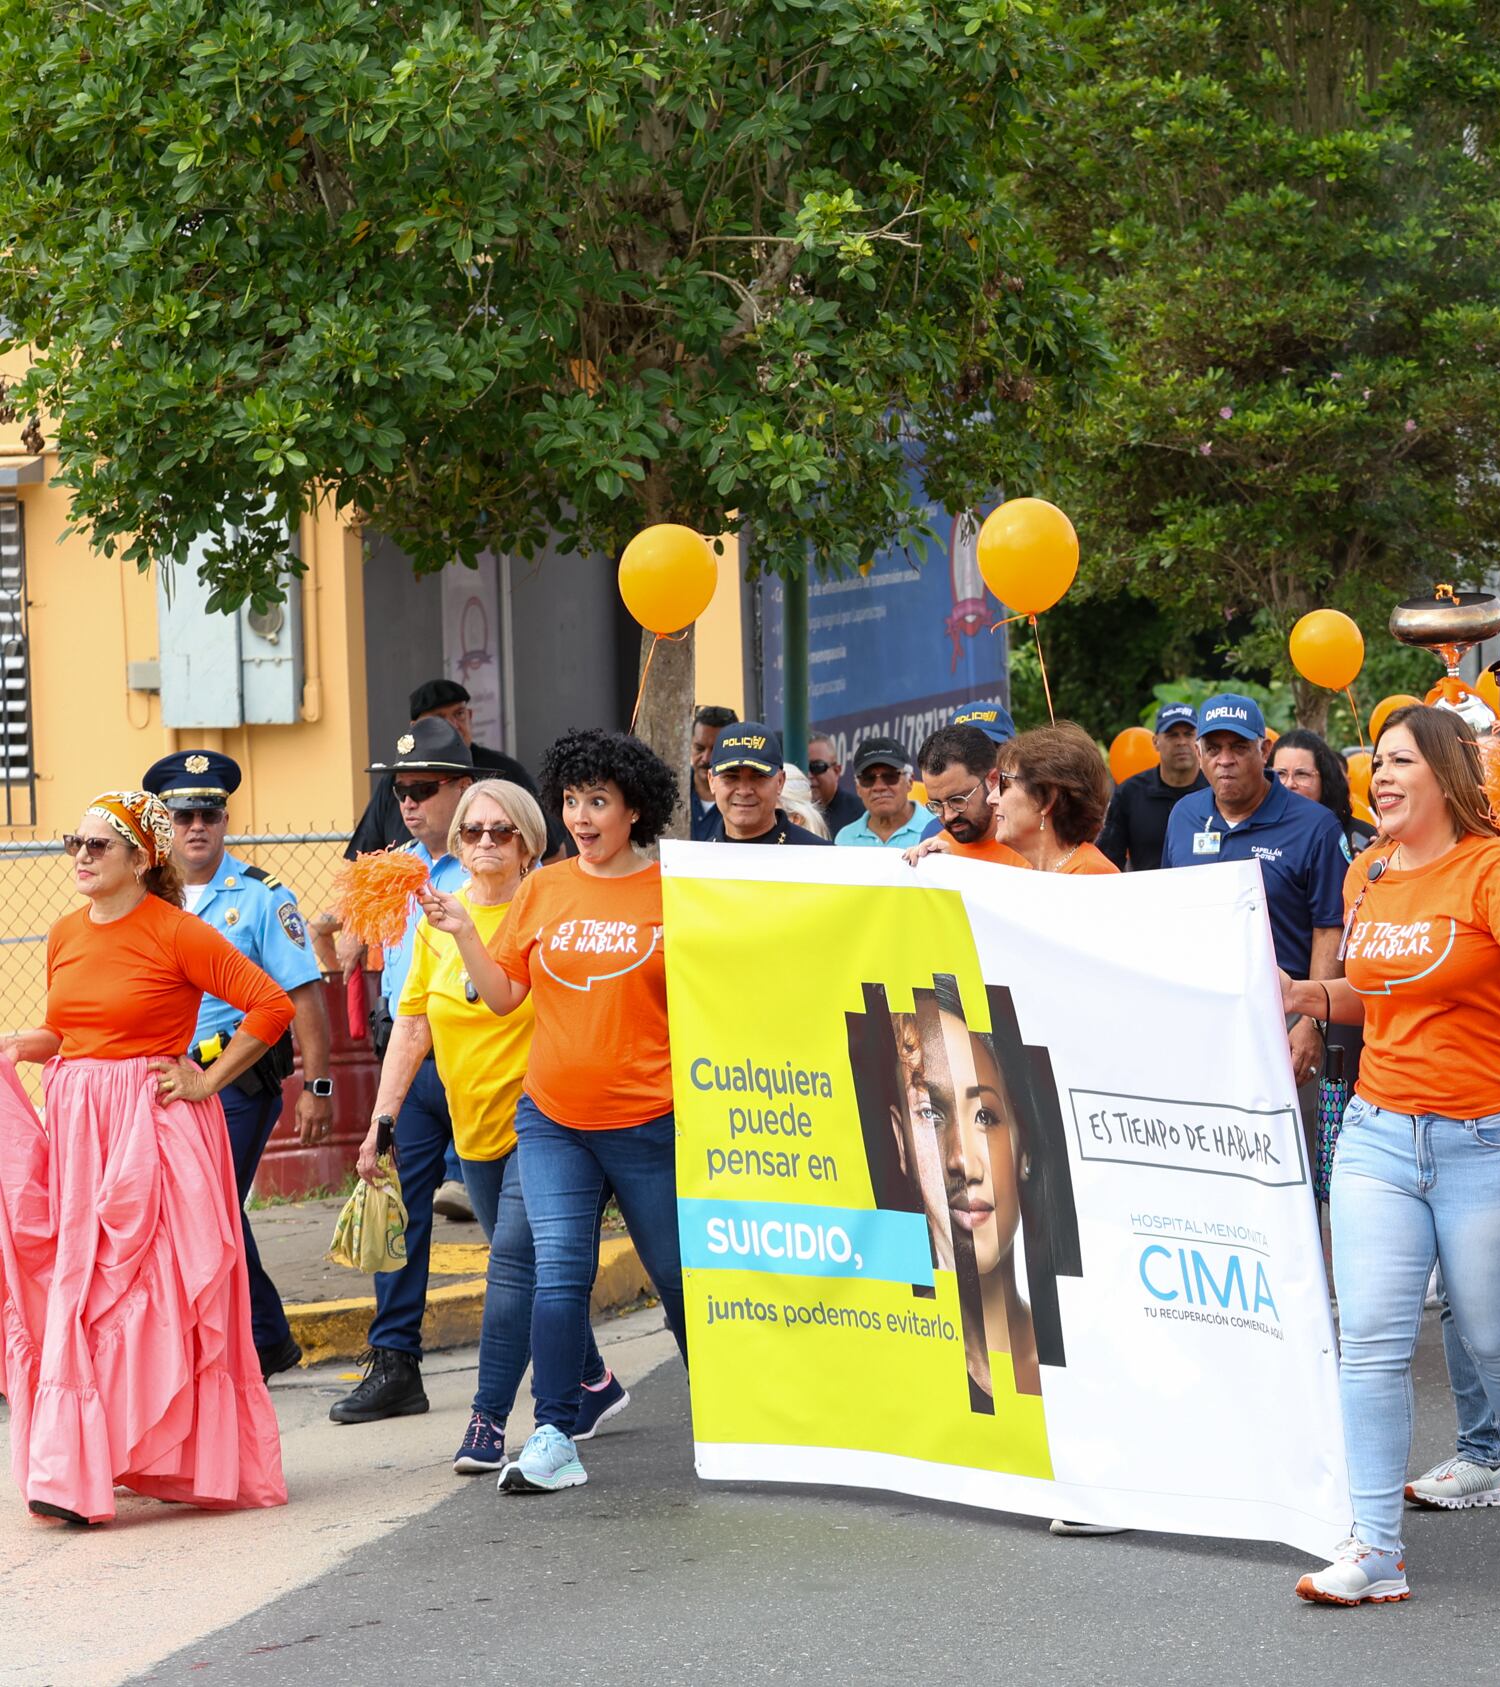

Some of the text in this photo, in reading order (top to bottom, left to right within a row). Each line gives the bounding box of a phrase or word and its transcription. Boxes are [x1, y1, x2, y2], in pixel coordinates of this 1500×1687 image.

[1205, 706, 1247, 721] CAPELLÁN
[723, 736, 760, 748] POLICIA
[1251, 846, 1283, 857] CAPELLÁN
[558, 919, 637, 936] ES TIEMPO
[1354, 921, 1431, 939] ES TIEMPO
[550, 933, 638, 954] DE HABLAR
[1362, 936, 1433, 960] HABLAR
[690, 1057, 833, 1101] Cualquiera
[729, 1102, 812, 1140] puede
[1089, 1110, 1281, 1165] ES TIEMPO DE HABLAR
[707, 1148, 838, 1182] pensar en
[706, 1217, 863, 1270] SUICIDIO,
[1130, 1213, 1269, 1248] HOSPITAL MENONITA
[1139, 1244, 1281, 1323] CIMA
[707, 1295, 960, 1342] juntos podemos evitarlo.
[1144, 1307, 1157, 1318] TU
[1160, 1308, 1229, 1327] RECUPERACIÓN
[1230, 1316, 1270, 1335] COMIENZA
